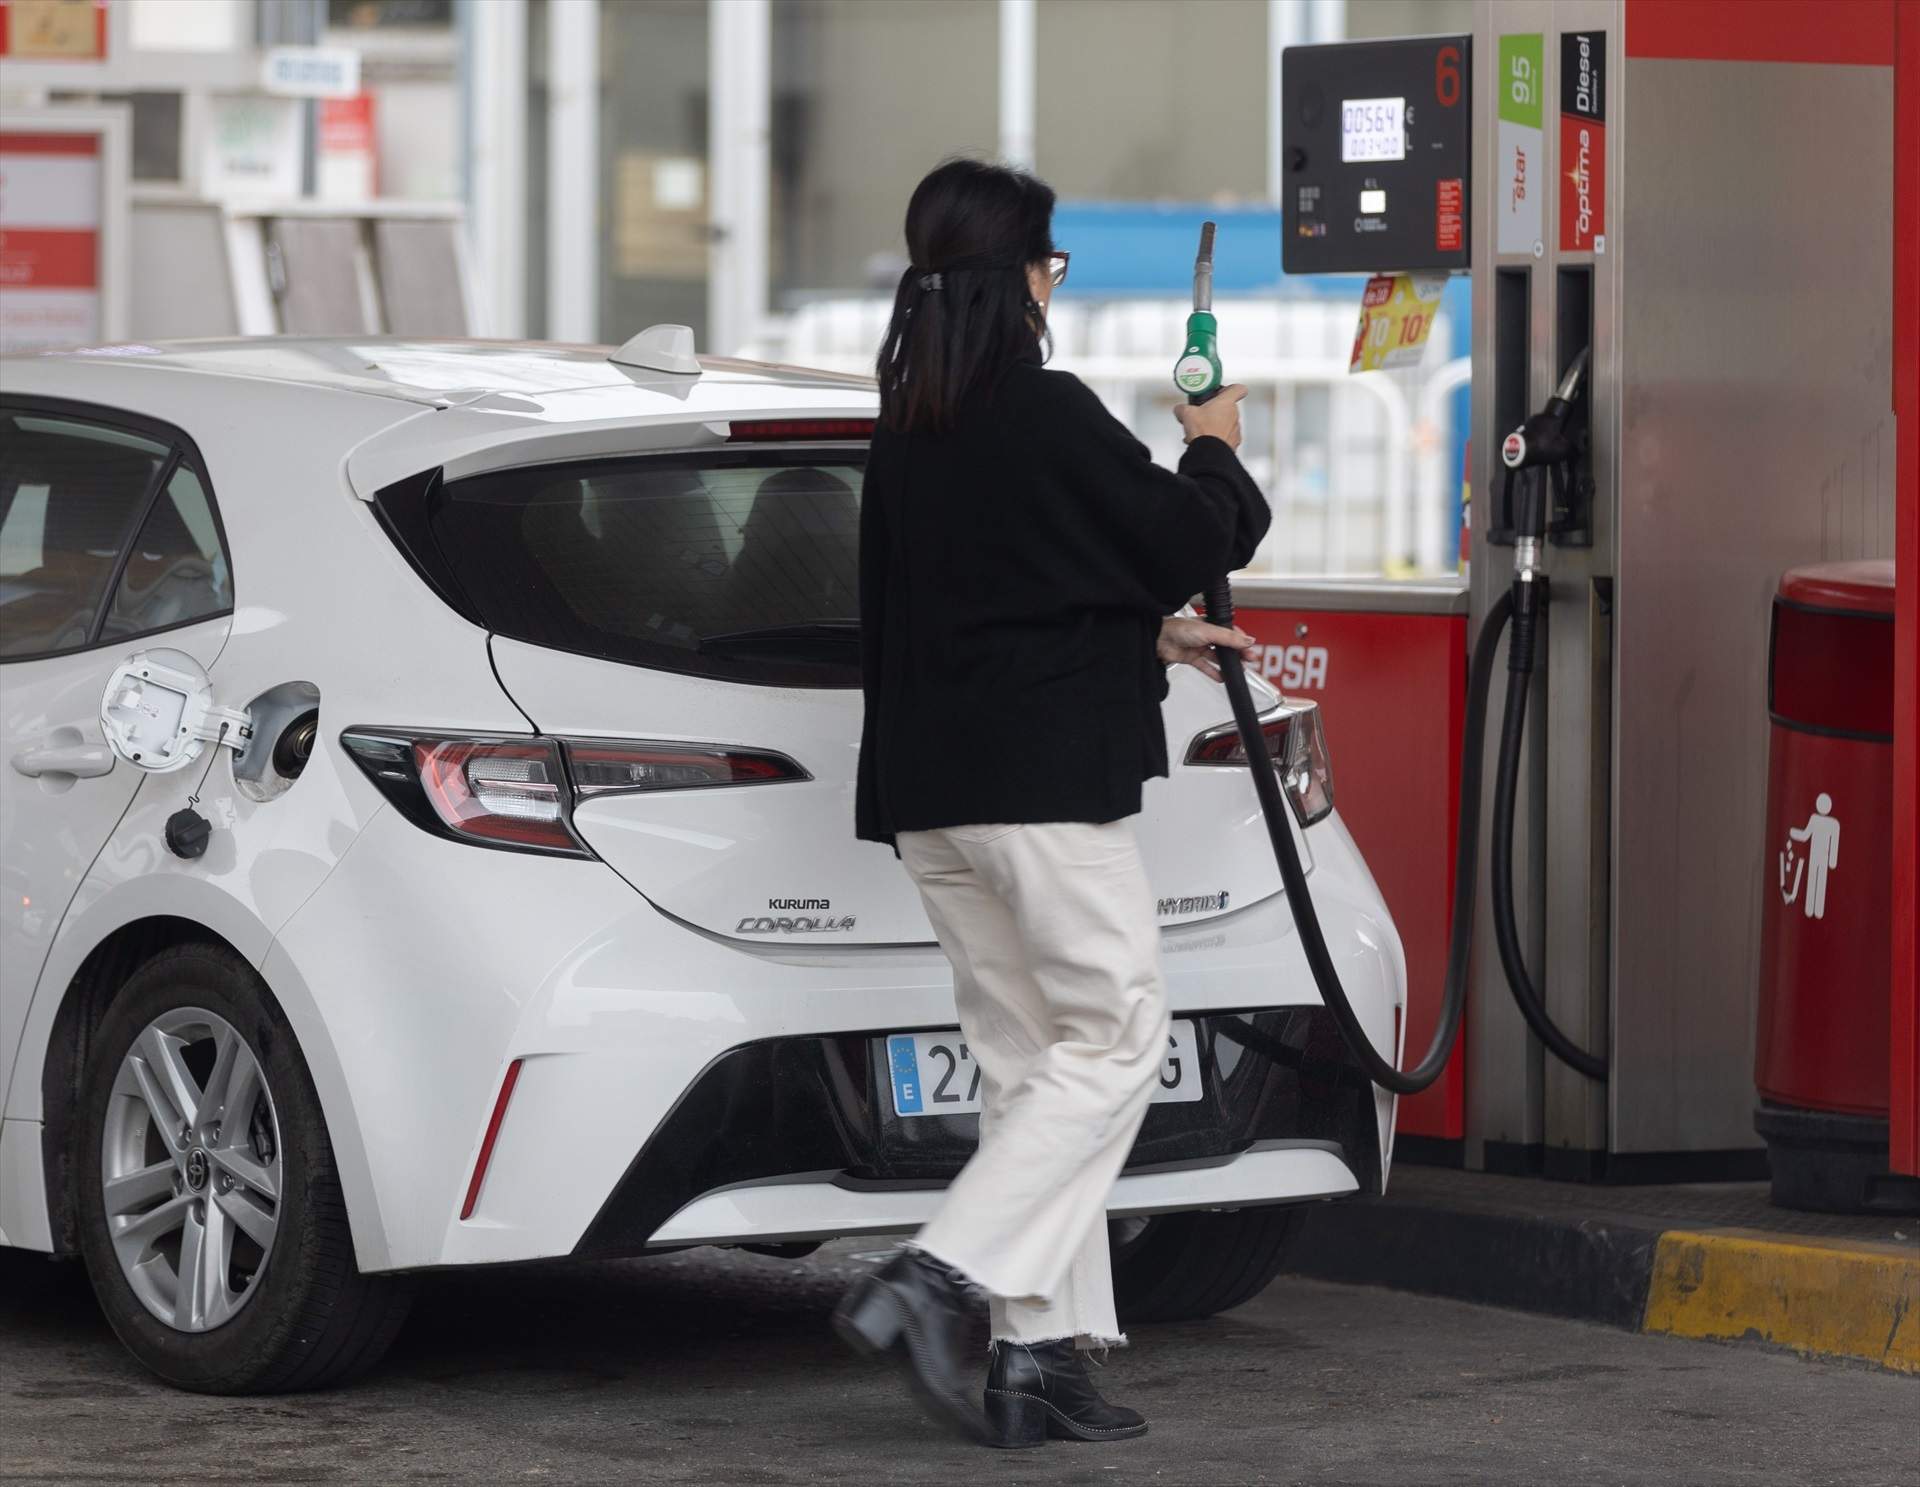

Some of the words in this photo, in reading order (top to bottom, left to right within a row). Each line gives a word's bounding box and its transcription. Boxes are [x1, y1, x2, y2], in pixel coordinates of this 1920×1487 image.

[1435, 46, 1461, 107] 6
[1511, 55, 1531, 105] 95
[1576, 35, 1590, 113] Diesel
[1514, 144, 1526, 201] star
[1578, 128, 1593, 234] optima
[1399, 313, 1424, 346] 10
[735, 915, 857, 934] COROLLA
[1156, 894, 1217, 915] HYBRID
[902, 1083, 915, 1100] E
